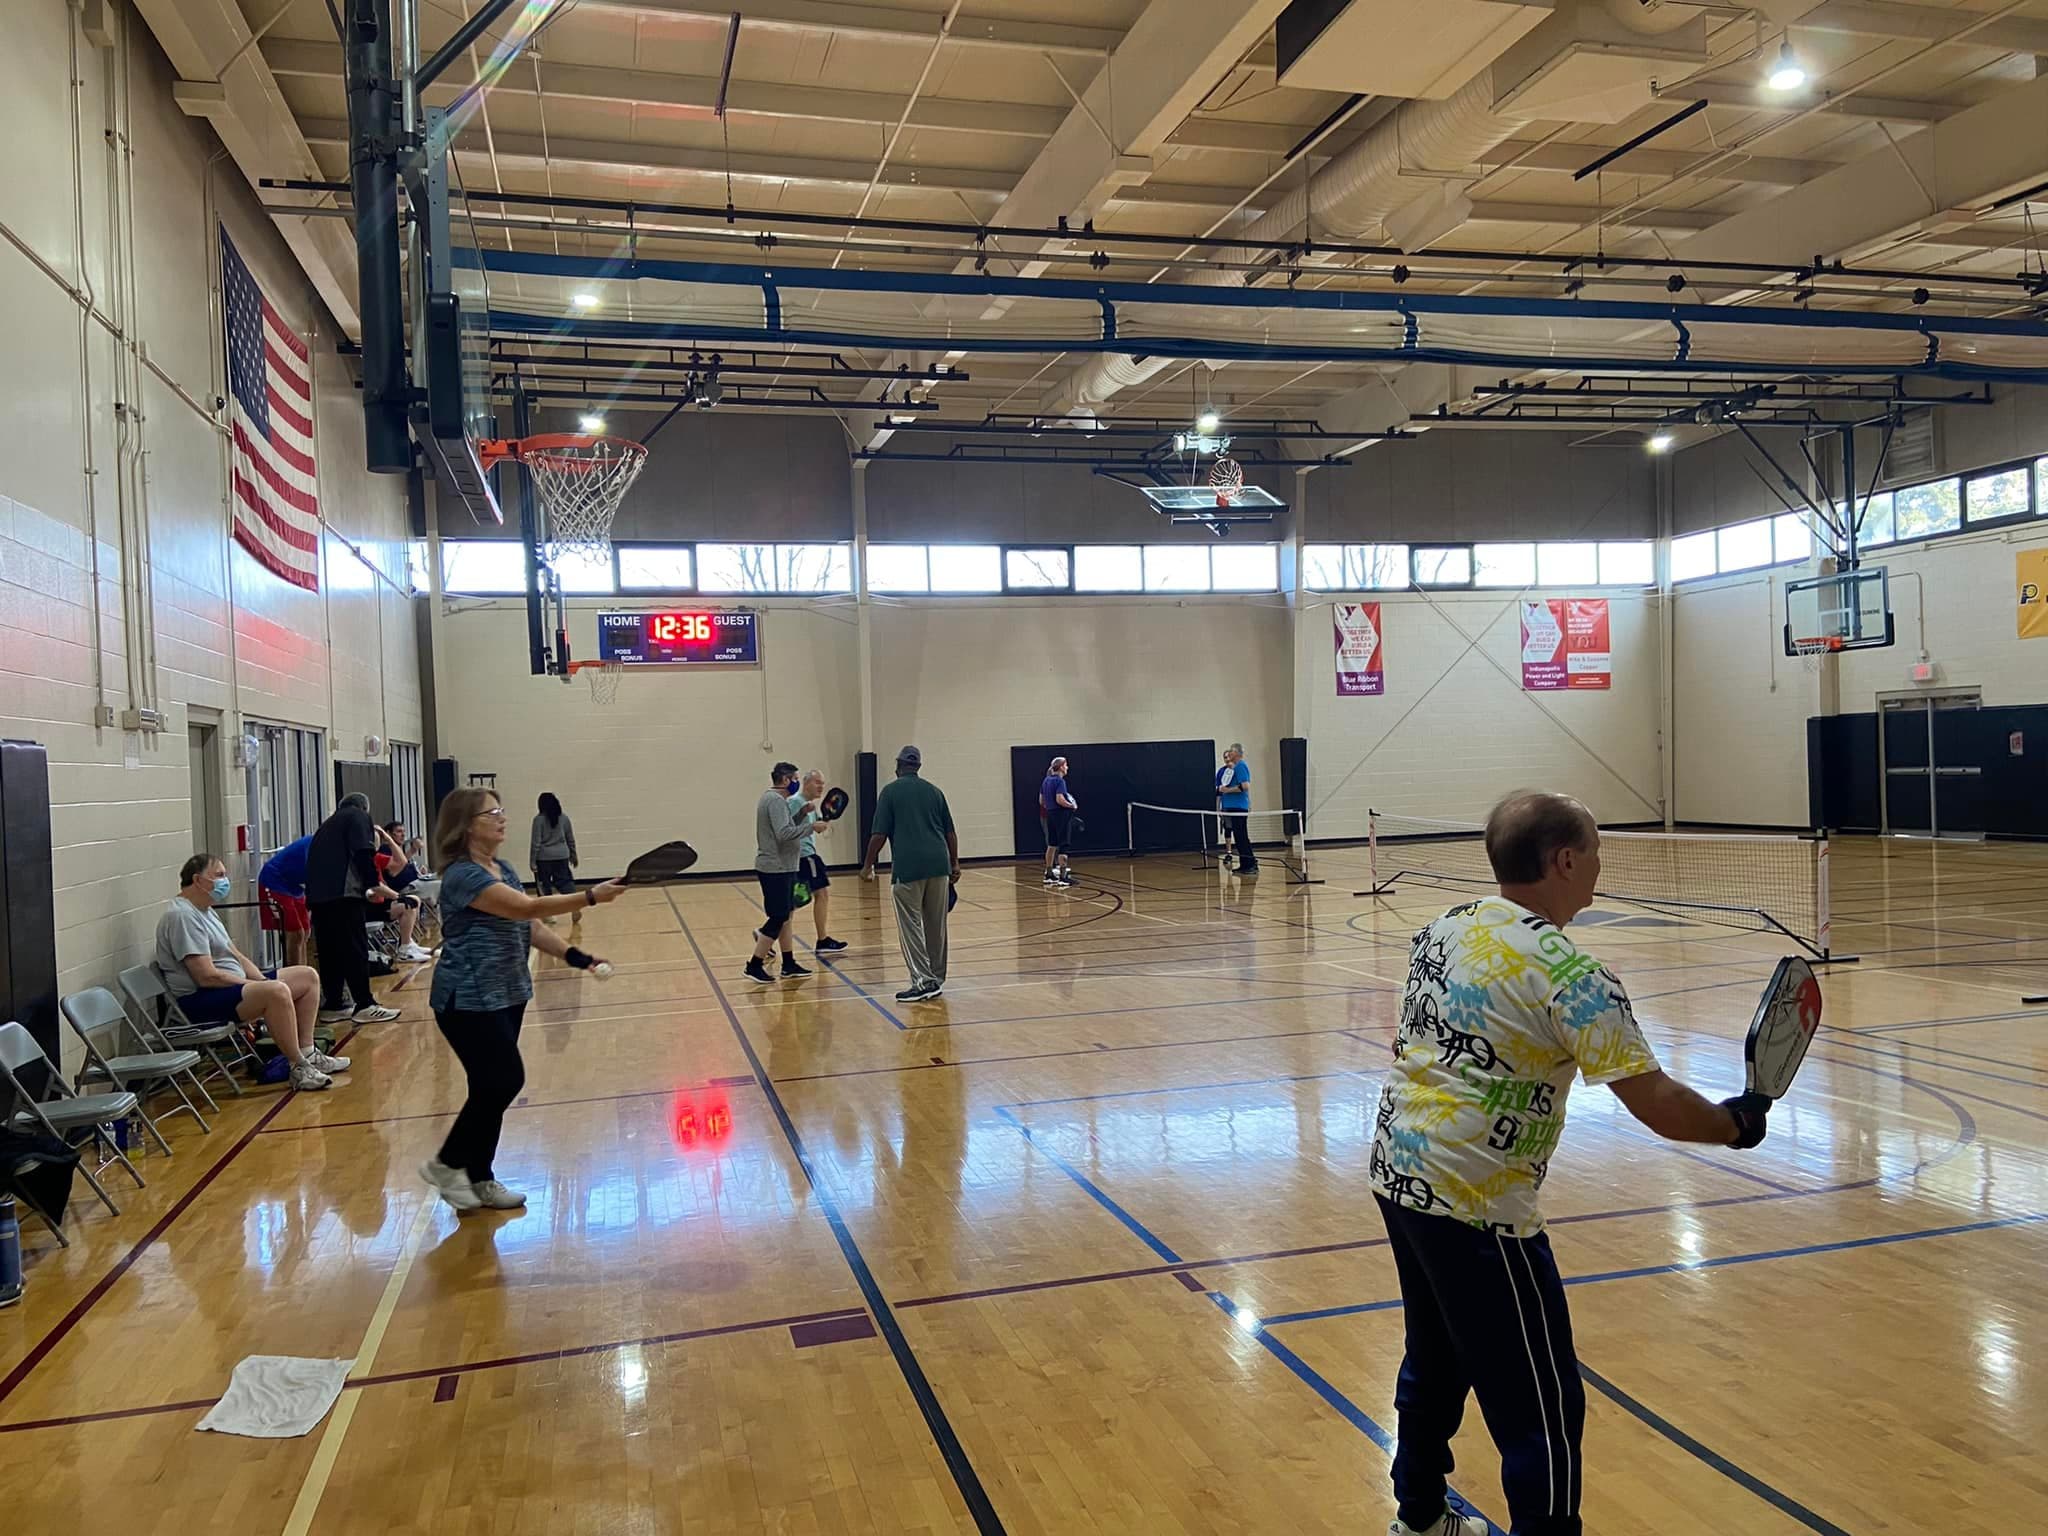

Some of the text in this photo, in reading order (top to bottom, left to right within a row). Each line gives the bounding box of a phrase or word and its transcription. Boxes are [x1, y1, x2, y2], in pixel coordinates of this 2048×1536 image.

[604, 616, 640, 626] HOME
[713, 616, 751, 626] GUEST
[654, 616, 710, 640] 12:36
